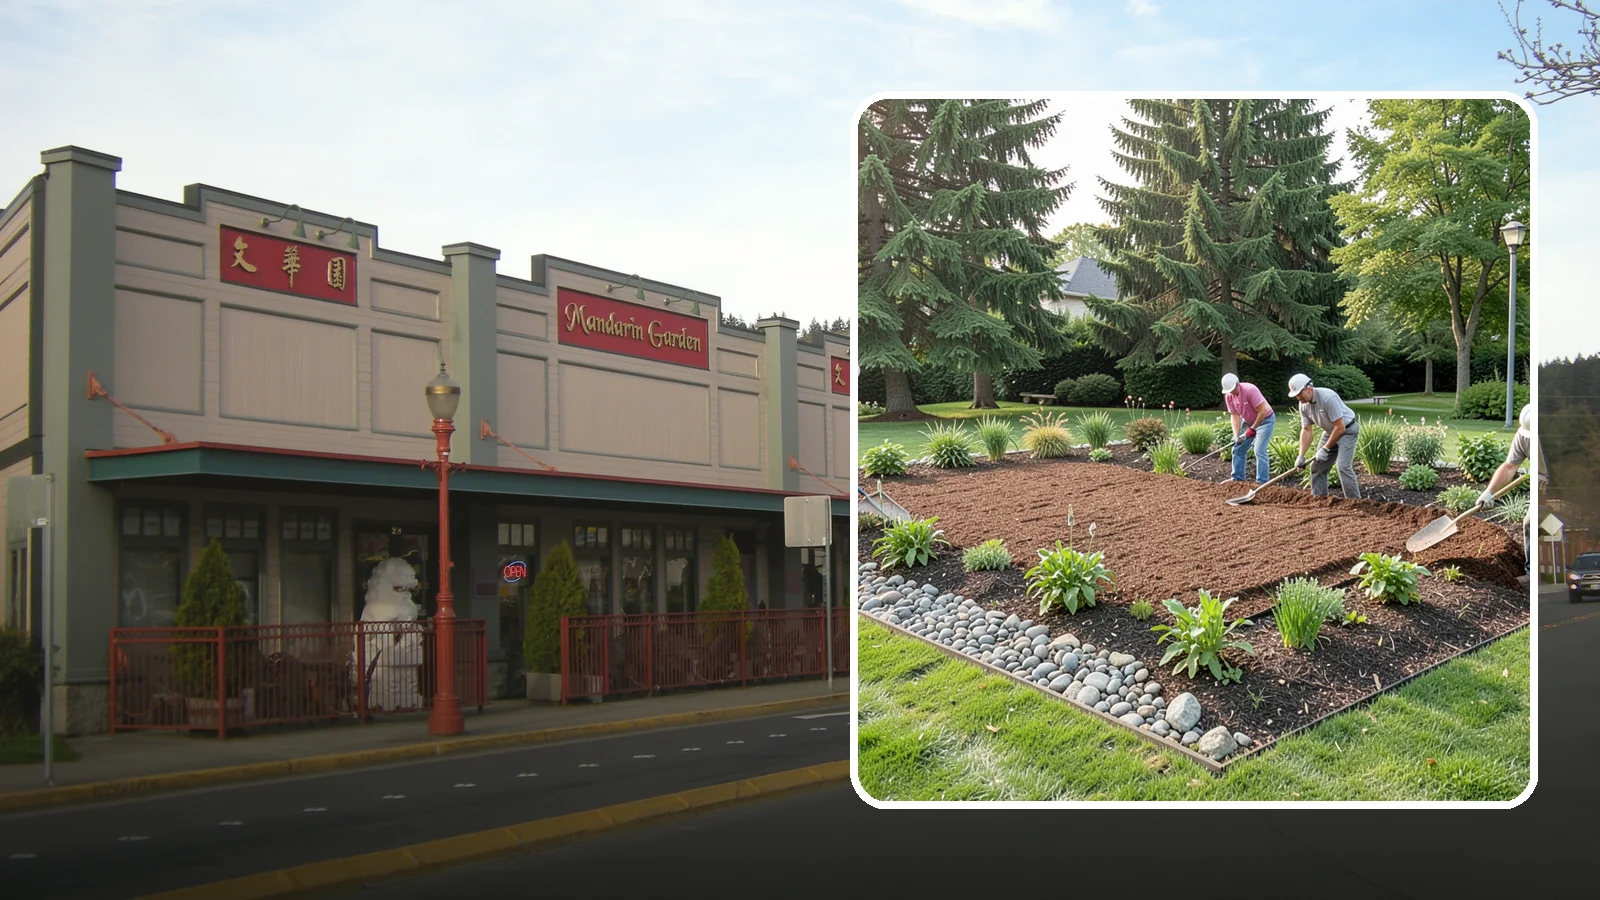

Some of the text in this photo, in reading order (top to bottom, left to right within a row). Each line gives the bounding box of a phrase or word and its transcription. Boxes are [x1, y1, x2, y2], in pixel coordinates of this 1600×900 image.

[231, 236, 346, 291] 文華園
[564, 302, 701, 352] Mandarin Garden
[835, 363, 846, 386] 文
[503, 565, 527, 578] OPEN
